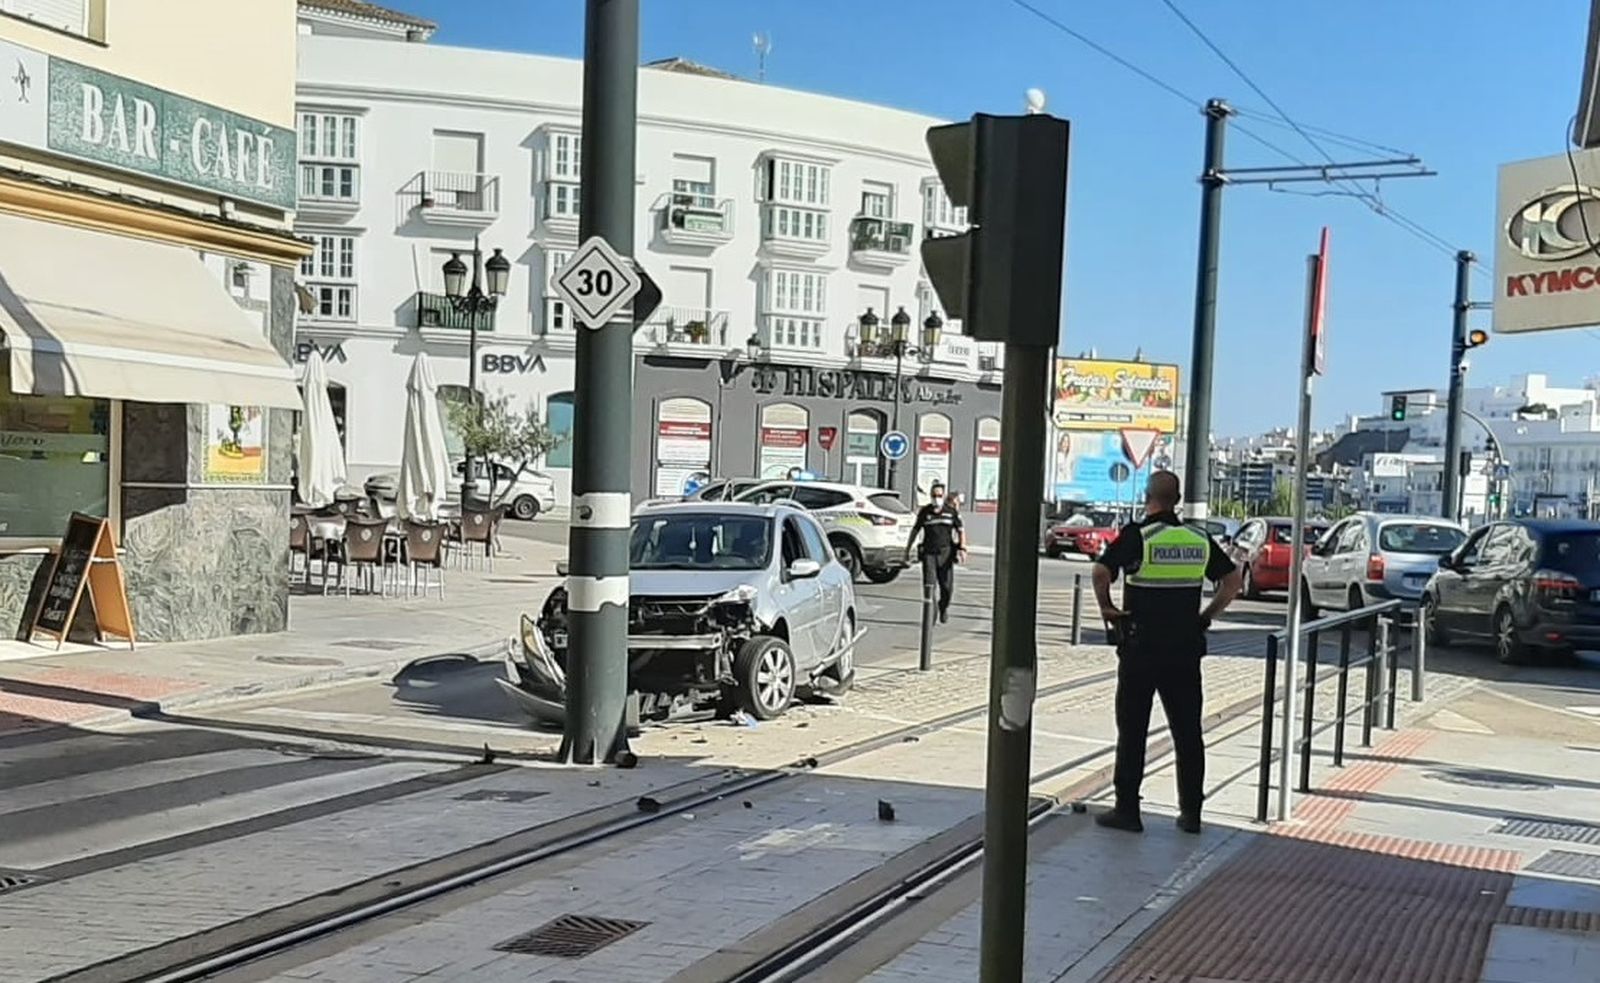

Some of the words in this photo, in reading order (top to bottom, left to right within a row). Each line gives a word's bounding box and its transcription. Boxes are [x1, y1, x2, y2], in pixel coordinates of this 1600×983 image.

[80, 82, 159, 161] BAR
[191, 116, 275, 190] CAFÉ
[576, 268, 614, 297] 30
[1506, 265, 1600, 298] KYMC
[481, 354, 547, 375] BBVA
